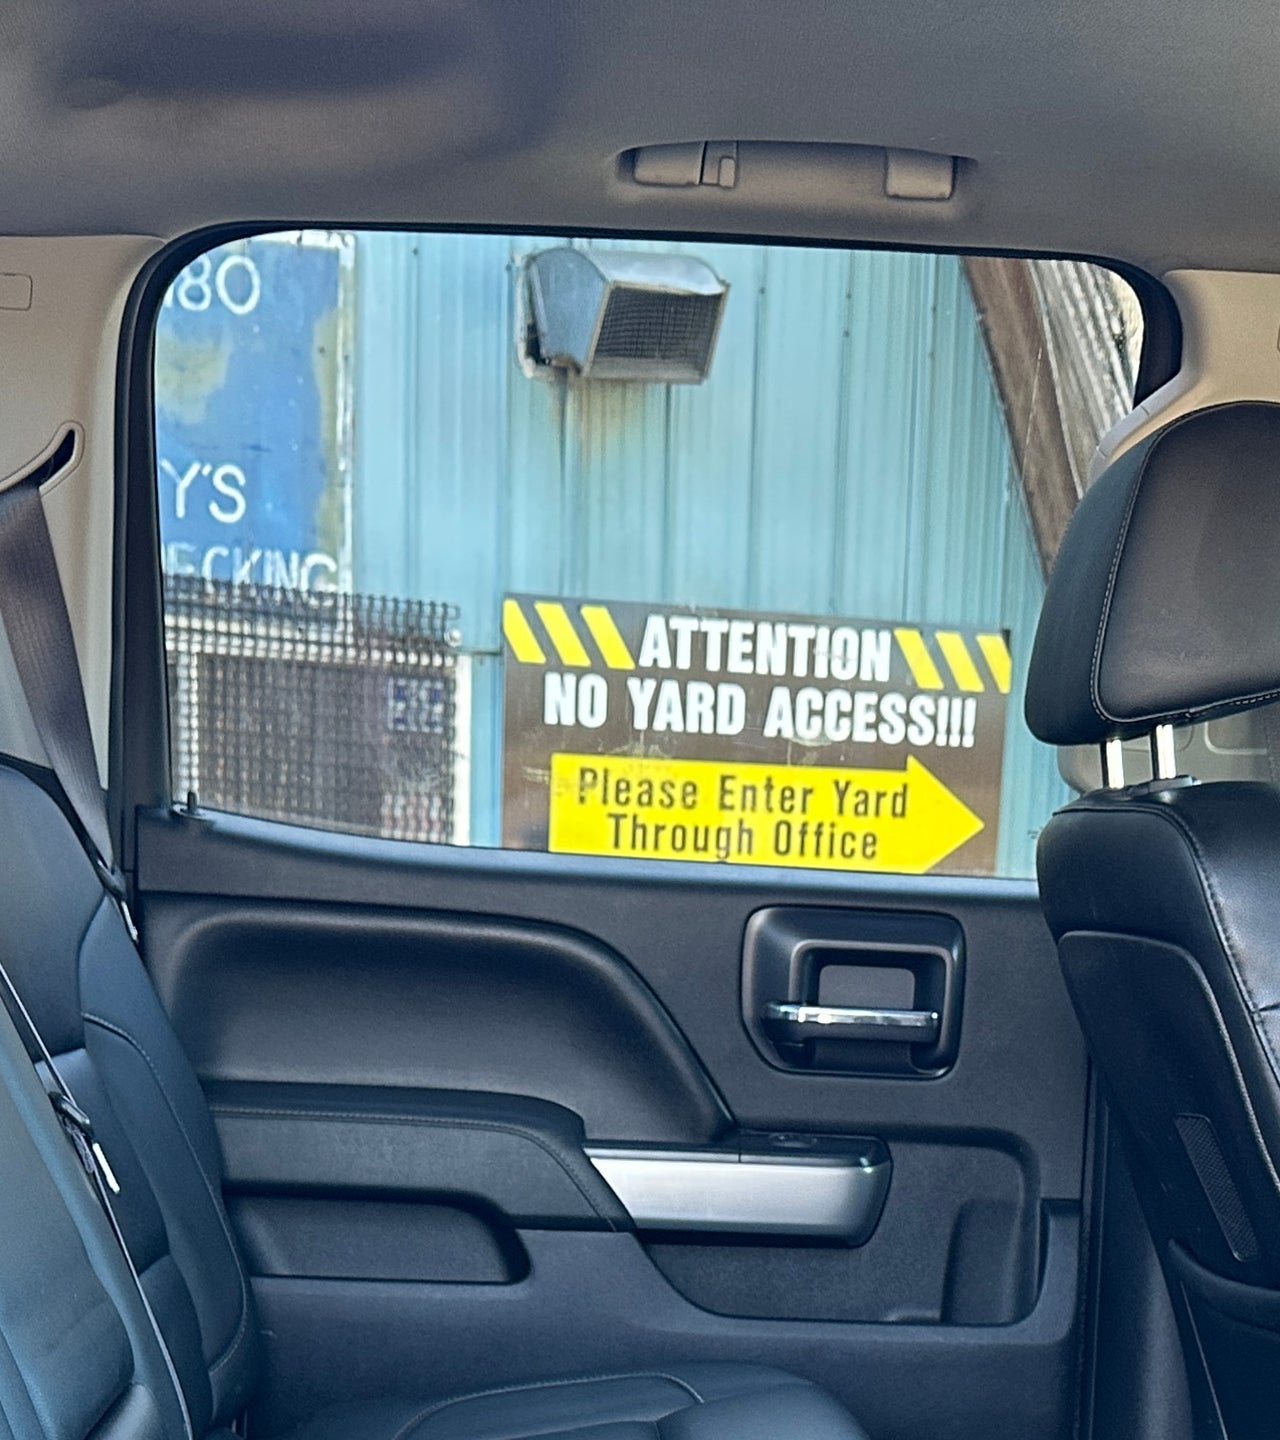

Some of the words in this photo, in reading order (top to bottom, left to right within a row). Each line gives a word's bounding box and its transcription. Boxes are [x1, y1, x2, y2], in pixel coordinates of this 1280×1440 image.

[162, 542, 338, 608] ECKING
[638, 615, 892, 682] ATTENTION
[543, 672, 608, 728] NO
[627, 678, 746, 734] YARD
[763, 686, 976, 747] ACCESS!!!
[578, 767, 698, 811] Please
[719, 774, 814, 816] Enter
[833, 780, 908, 819] Yard
[607, 813, 754, 862] Through
[773, 822, 878, 860] Office
